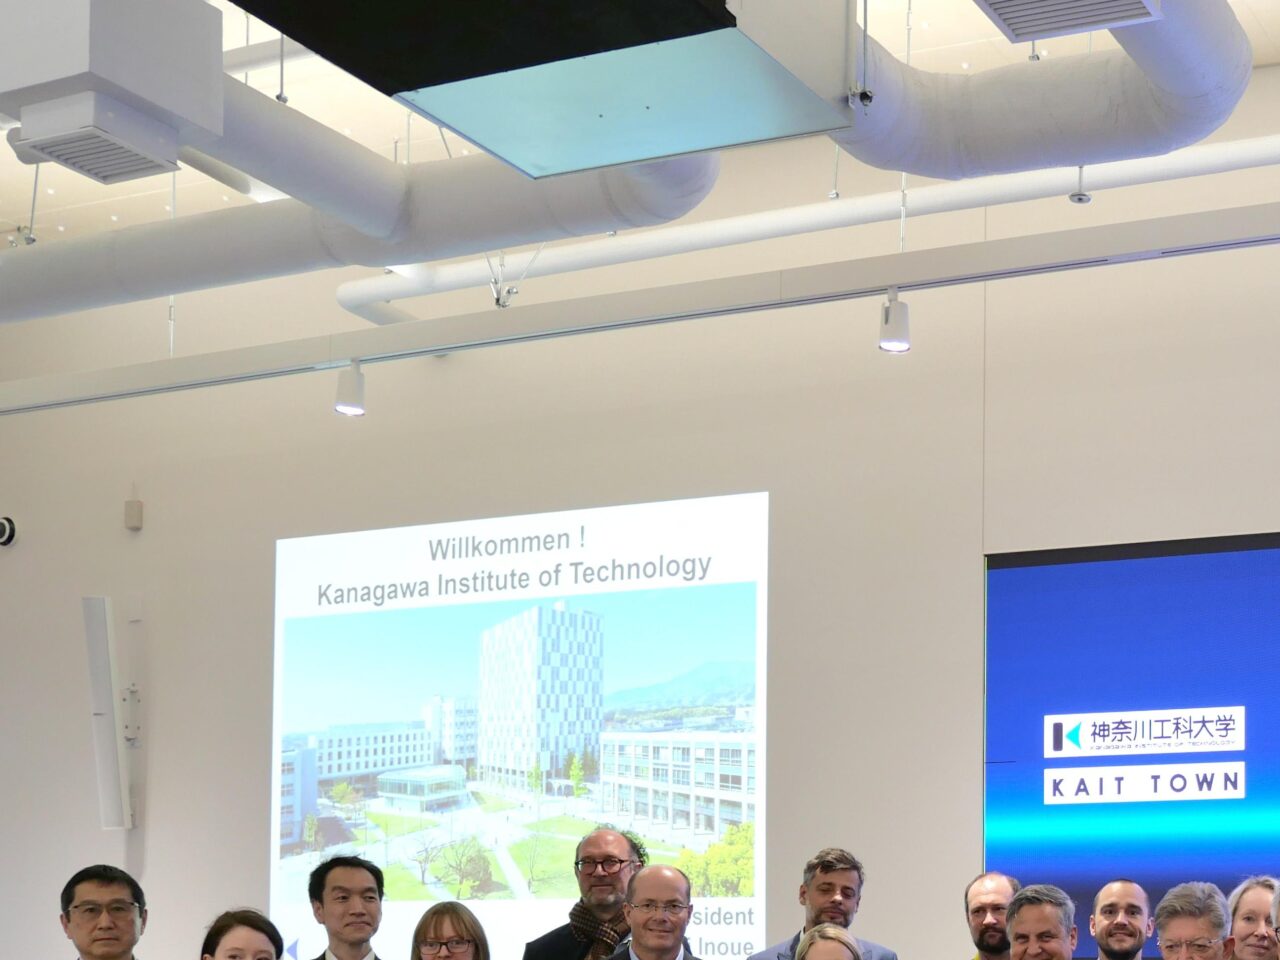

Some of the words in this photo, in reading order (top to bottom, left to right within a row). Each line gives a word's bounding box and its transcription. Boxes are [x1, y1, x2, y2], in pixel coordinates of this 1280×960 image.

[428, 532, 570, 561] Willkommen
[317, 579, 430, 607] Kanagawa
[438, 568, 530, 595] Institute
[539, 563, 562, 587] of
[569, 555, 712, 584] Technology
[1090, 714, 1236, 743] 神奈川工科大学
[1052, 776, 1125, 797] KAIT
[1151, 772, 1238, 793] TOWN
[692, 907, 754, 926] sident
[699, 937, 754, 956] Inoue
